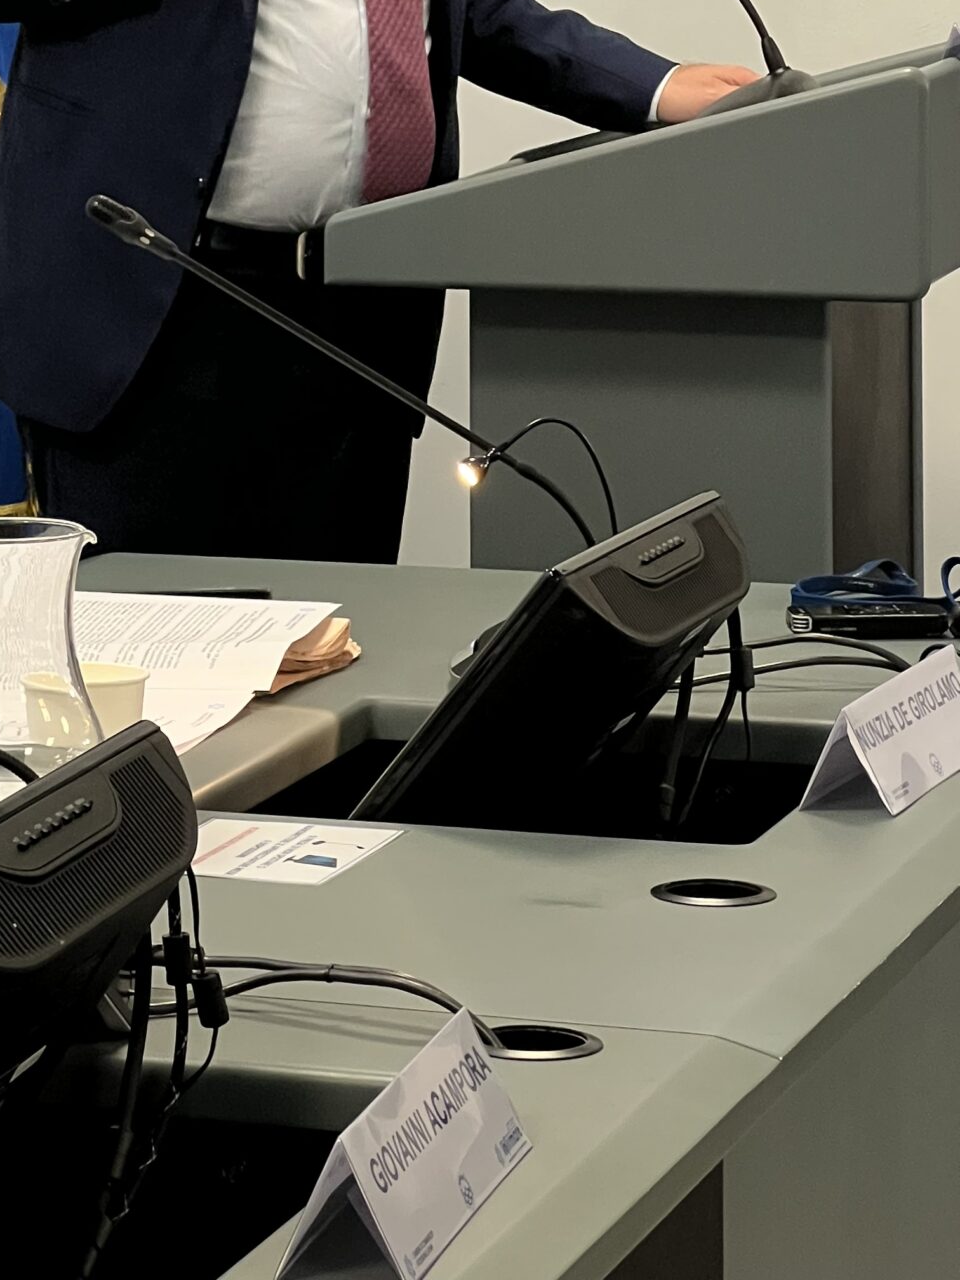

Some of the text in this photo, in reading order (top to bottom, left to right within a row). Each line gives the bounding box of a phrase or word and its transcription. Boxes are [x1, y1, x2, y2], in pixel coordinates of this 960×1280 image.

[855, 671, 960, 752] NUNZIA DE GIROLAMO
[369, 1045, 492, 1194] GIOVANNI ACAMPORA
